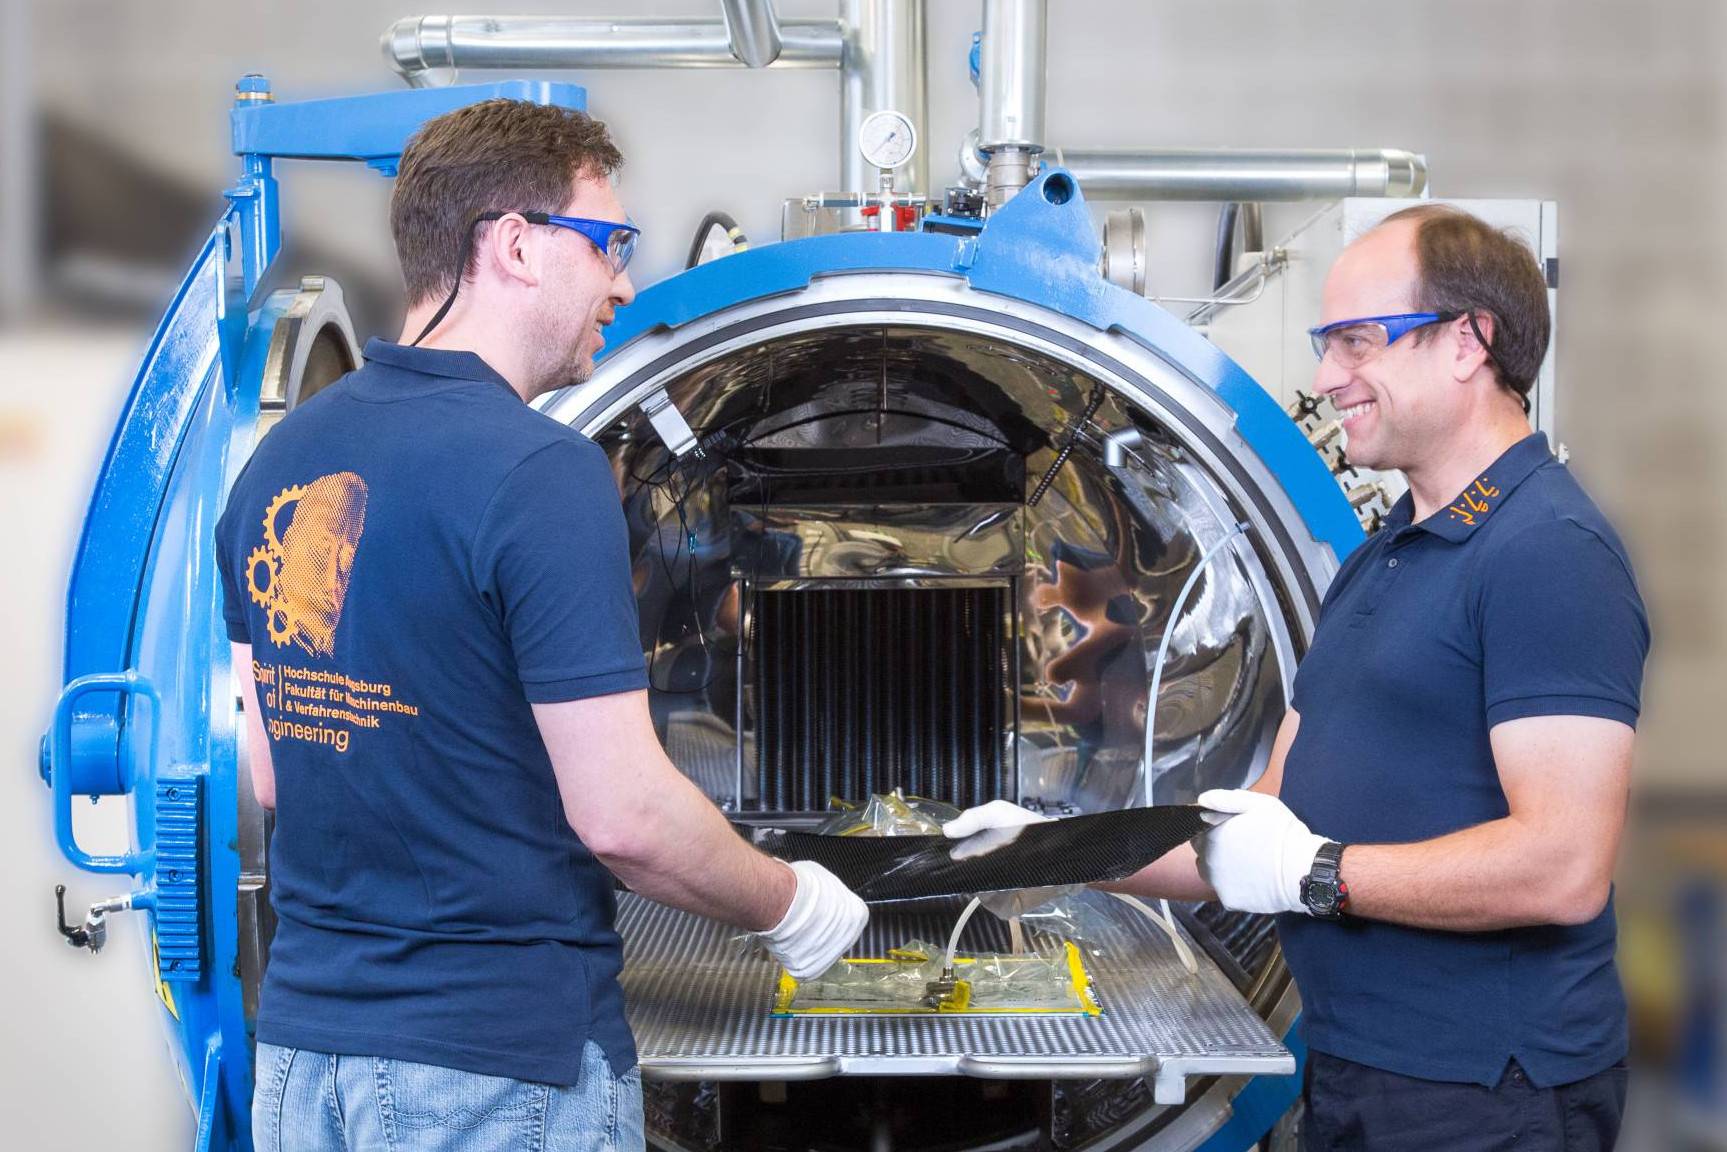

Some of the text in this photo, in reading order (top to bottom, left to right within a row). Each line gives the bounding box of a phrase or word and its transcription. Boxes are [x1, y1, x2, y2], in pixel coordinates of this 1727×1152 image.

[284, 665, 345, 686] Hochschule
[266, 688, 276, 709] of
[285, 682, 326, 700] Fakultät
[329, 688, 344, 702] für
[285, 700, 293, 712] &
